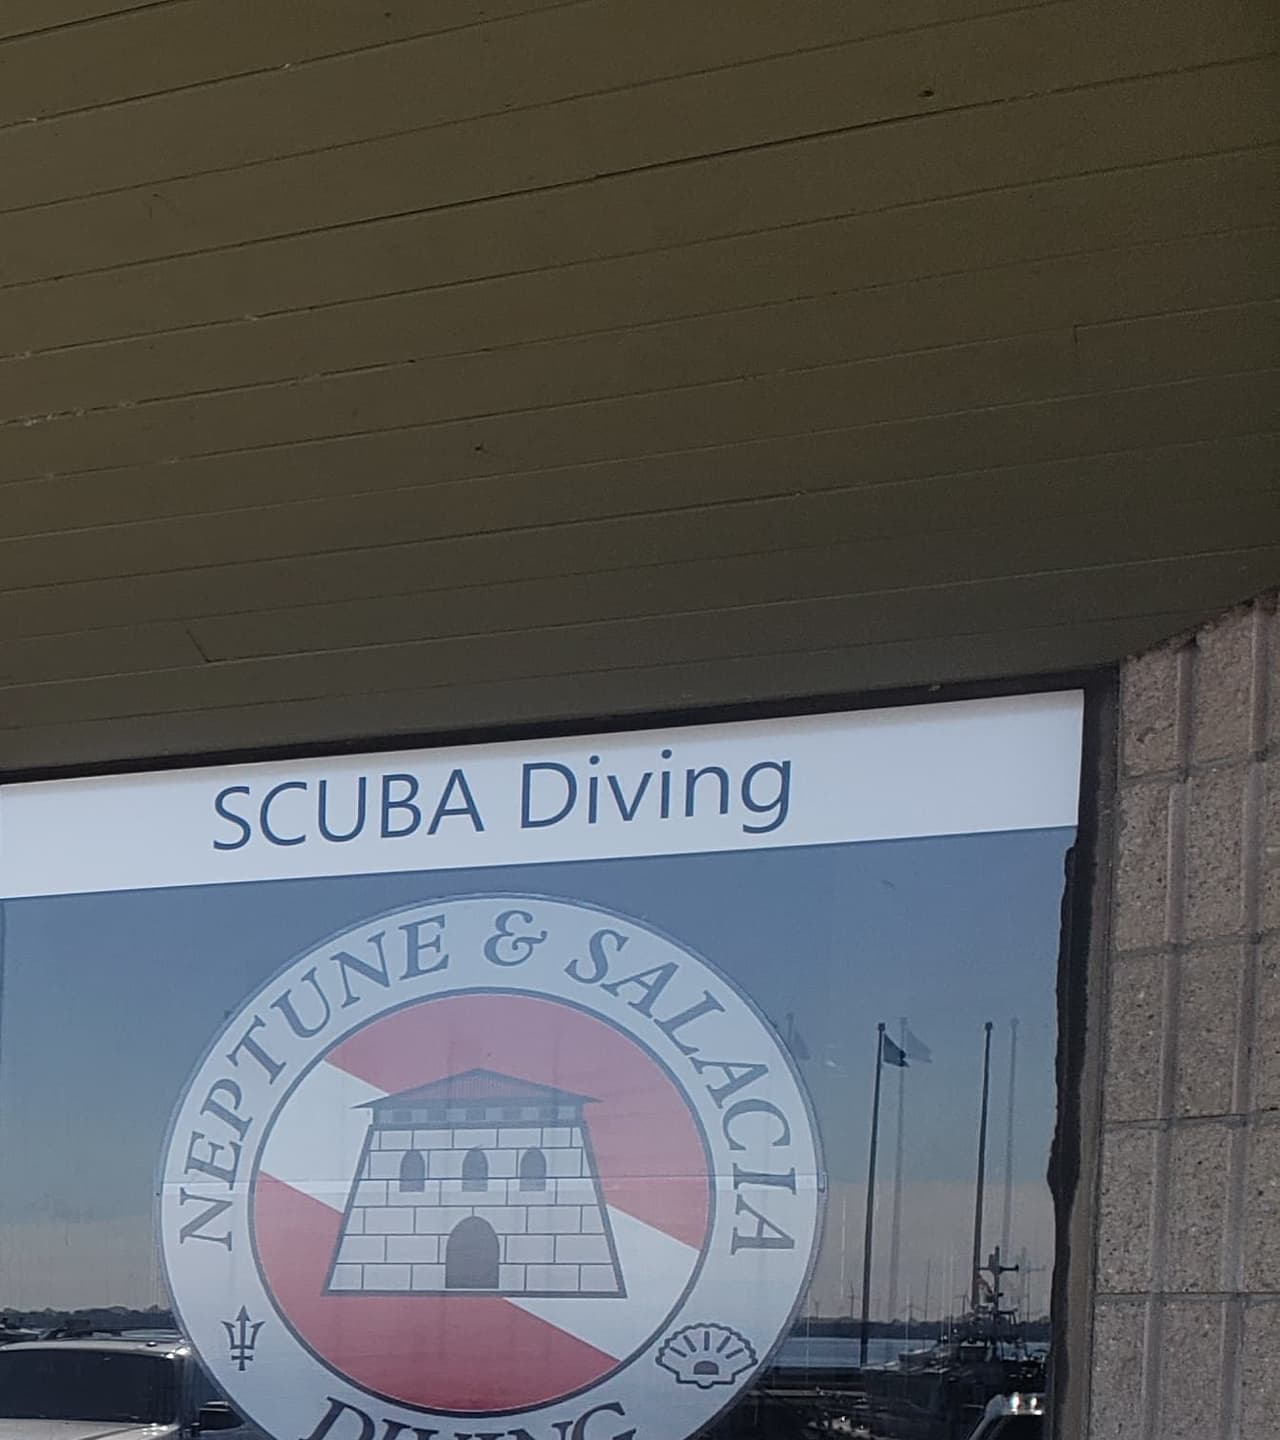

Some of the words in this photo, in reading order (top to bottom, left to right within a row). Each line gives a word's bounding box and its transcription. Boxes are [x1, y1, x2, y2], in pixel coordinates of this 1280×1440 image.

[213, 767, 485, 850] SCUBA
[520, 748, 792, 834] Diving
[179, 914, 450, 1251] NEPTUNE
[483, 909, 548, 967] &
[564, 928, 796, 1256] SALACIA
